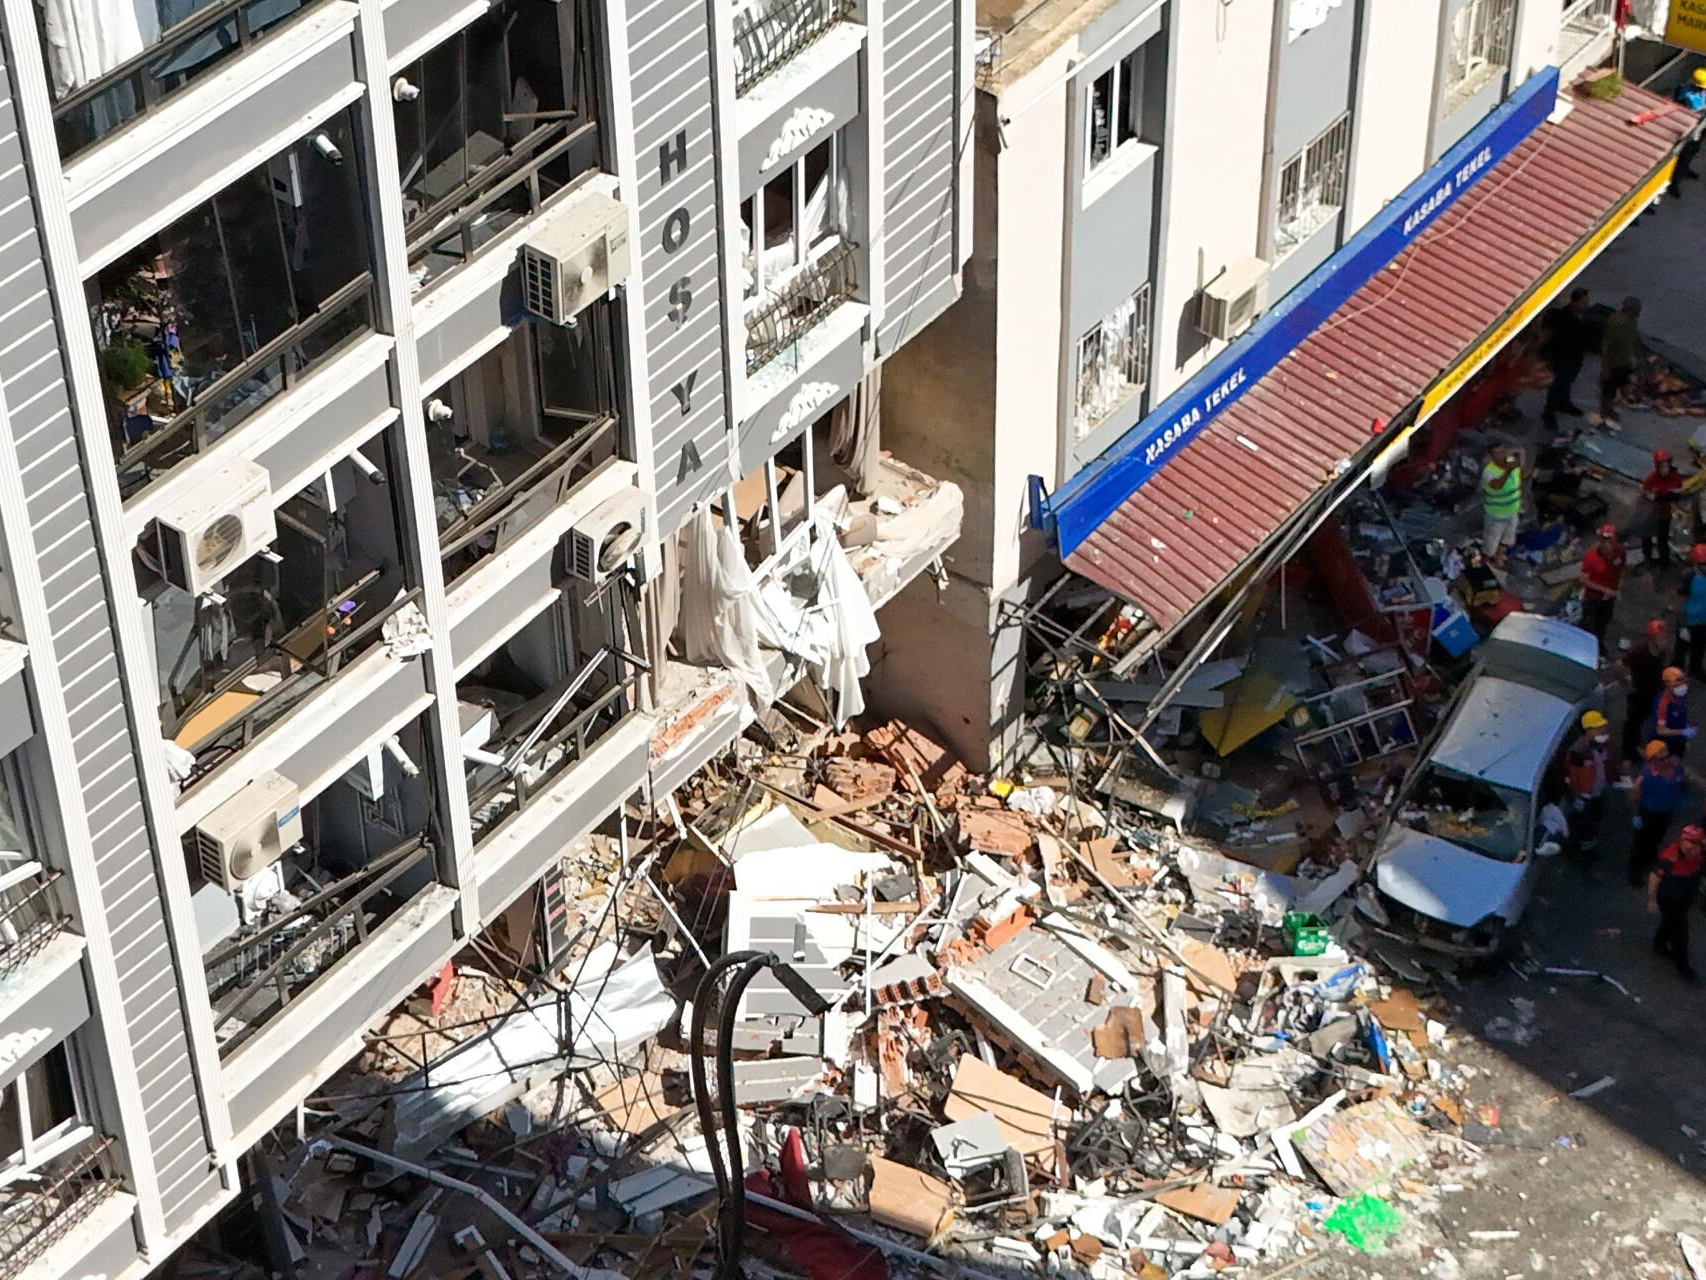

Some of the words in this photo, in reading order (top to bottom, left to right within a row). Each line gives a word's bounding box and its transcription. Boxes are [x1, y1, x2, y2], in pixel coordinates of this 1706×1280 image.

[1402, 185, 1453, 236] KASABA
[1454, 145, 1493, 189] TEKEL
[1145, 406, 1201, 465] KASABA
[1204, 367, 1246, 414] TEKEL
